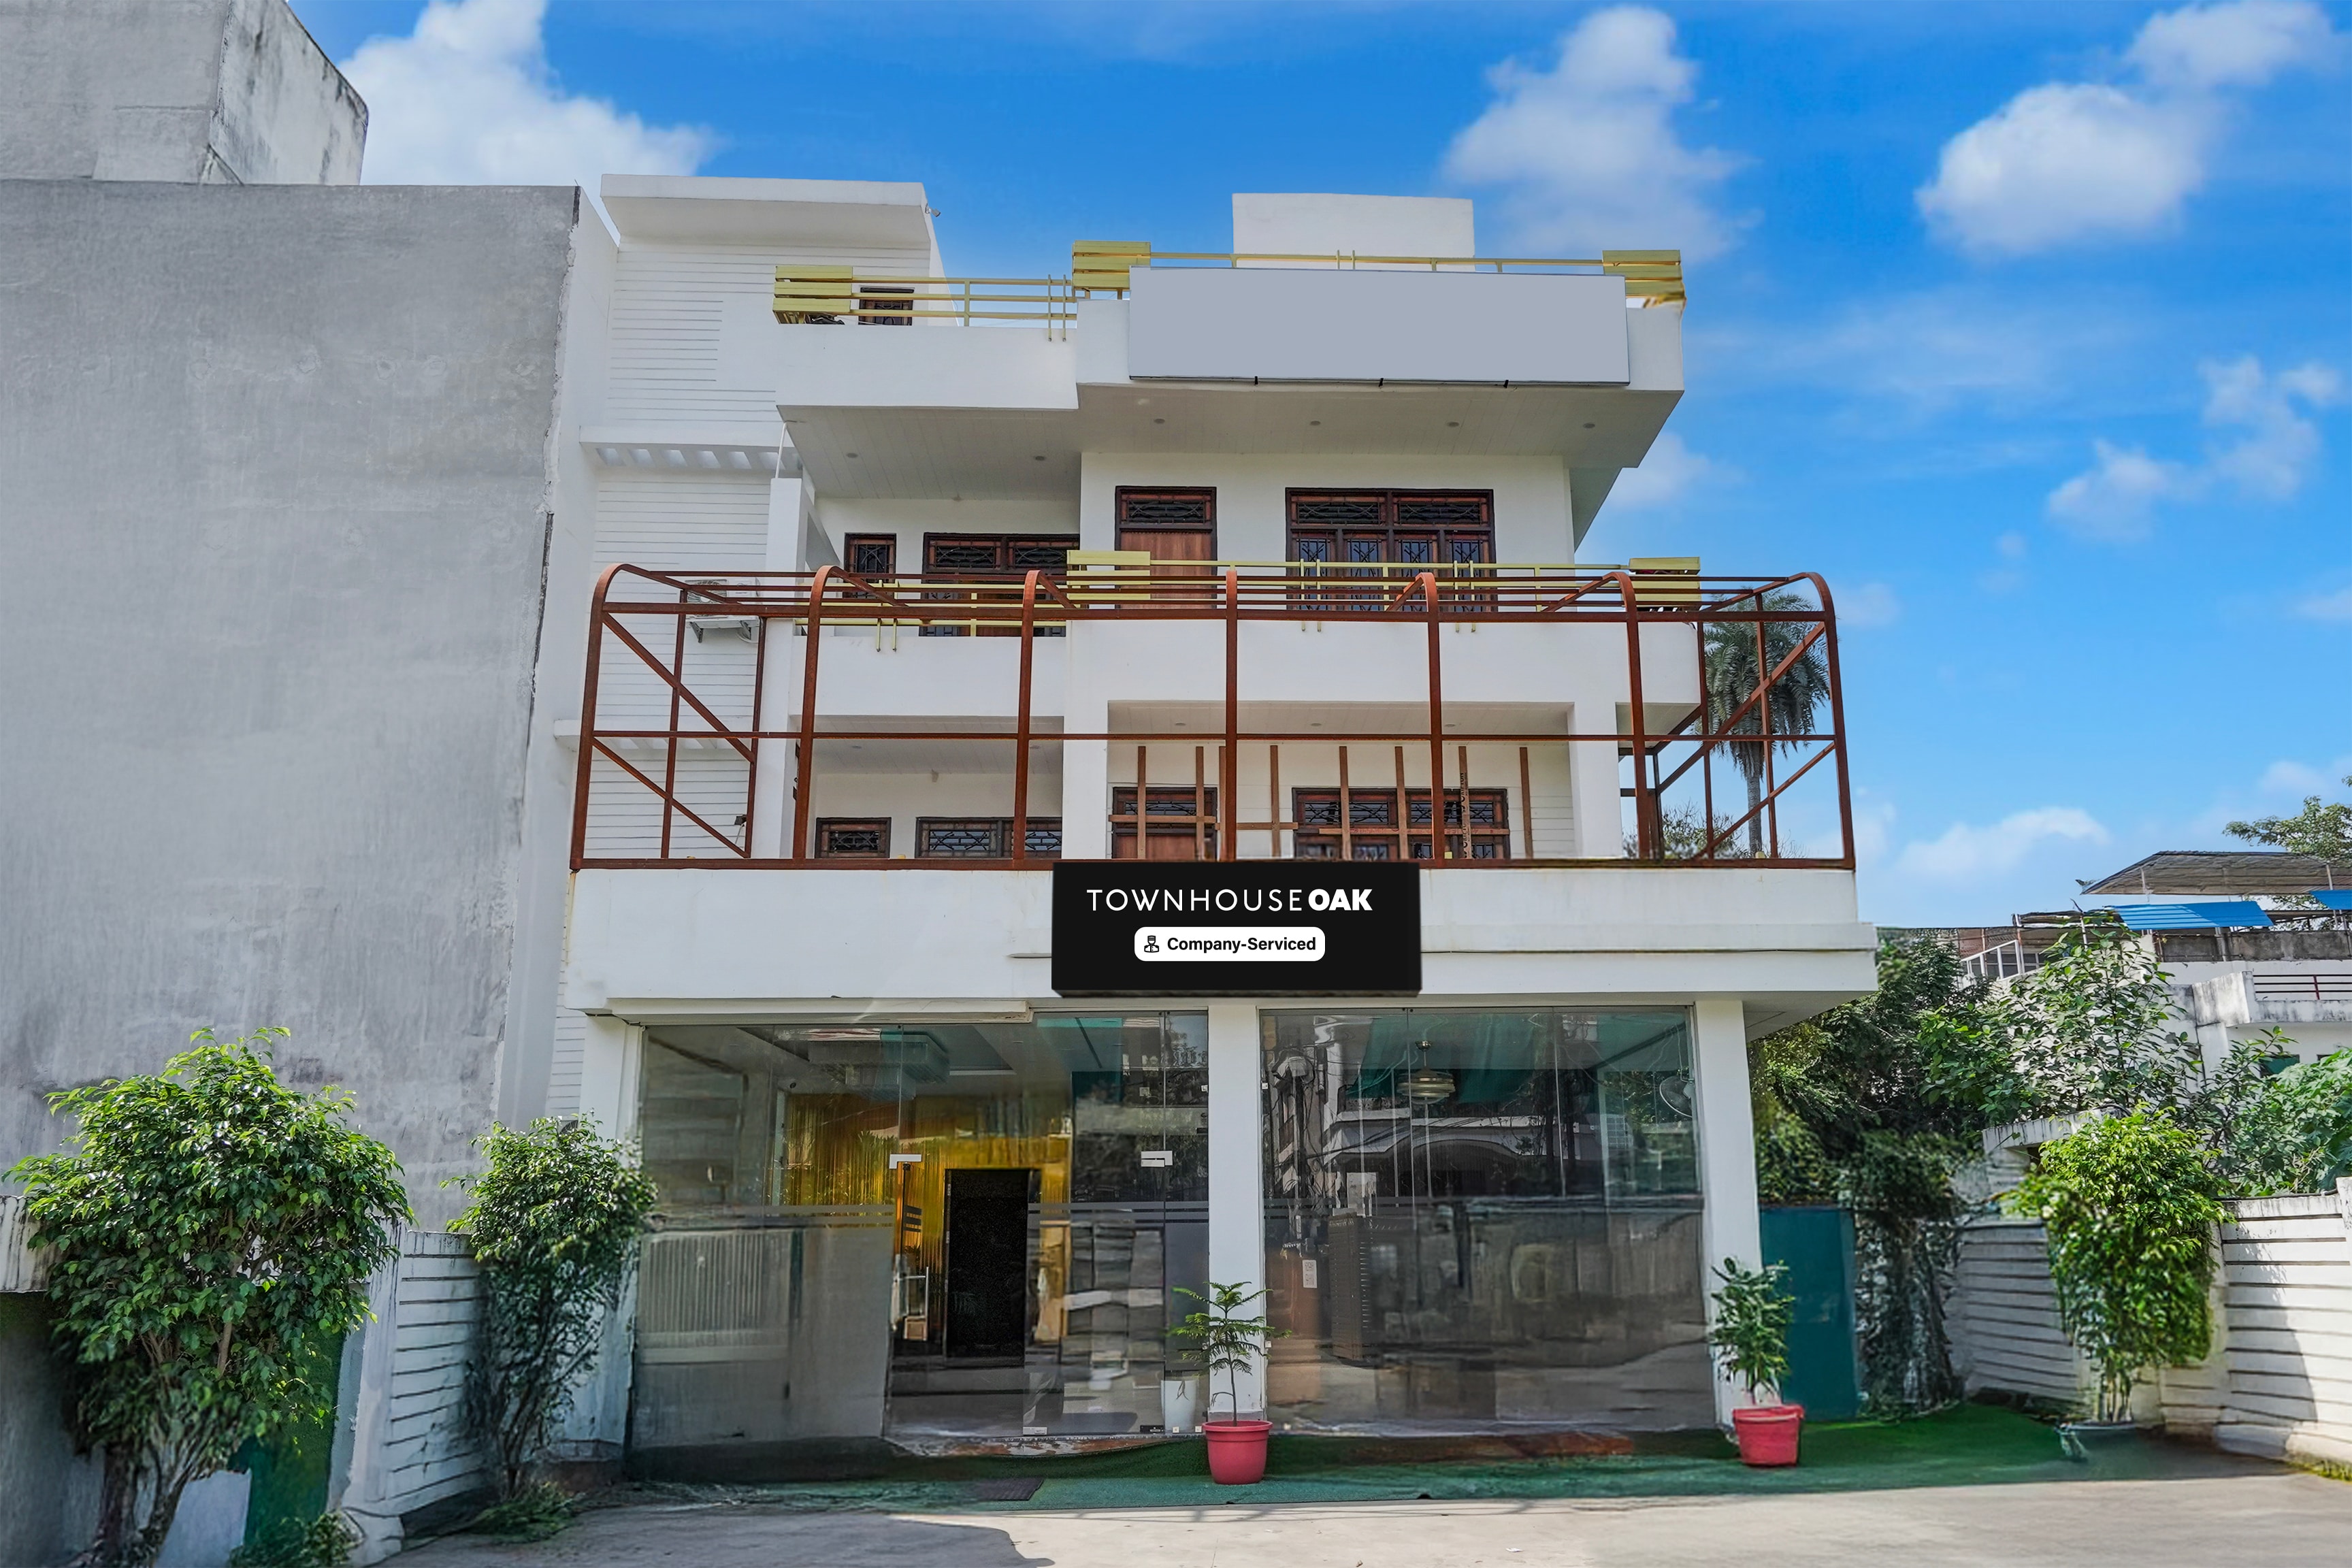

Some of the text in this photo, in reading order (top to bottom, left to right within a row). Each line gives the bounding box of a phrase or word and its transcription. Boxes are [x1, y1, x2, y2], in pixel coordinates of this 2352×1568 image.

[1087, 888, 1373, 911] TOWNHOUSE OAK
[1167, 936, 1316, 954] Company-Serviced
